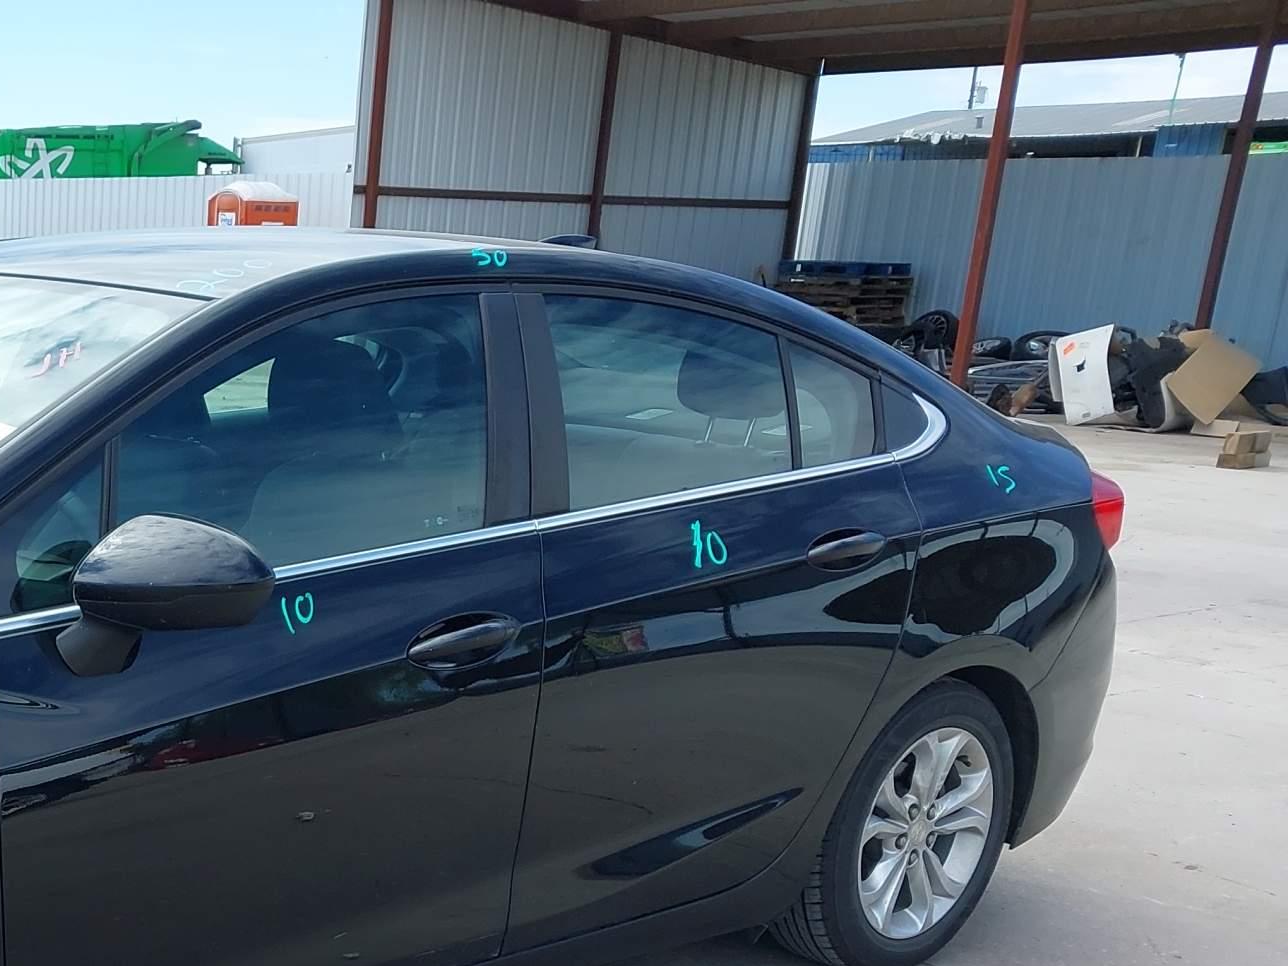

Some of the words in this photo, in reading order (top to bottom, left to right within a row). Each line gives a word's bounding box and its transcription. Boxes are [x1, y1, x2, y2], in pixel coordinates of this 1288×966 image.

[471, 247, 508, 267] 50
[986, 464, 1016, 494] 15
[691, 519, 728, 569] 10
[281, 591, 314, 635] 10
